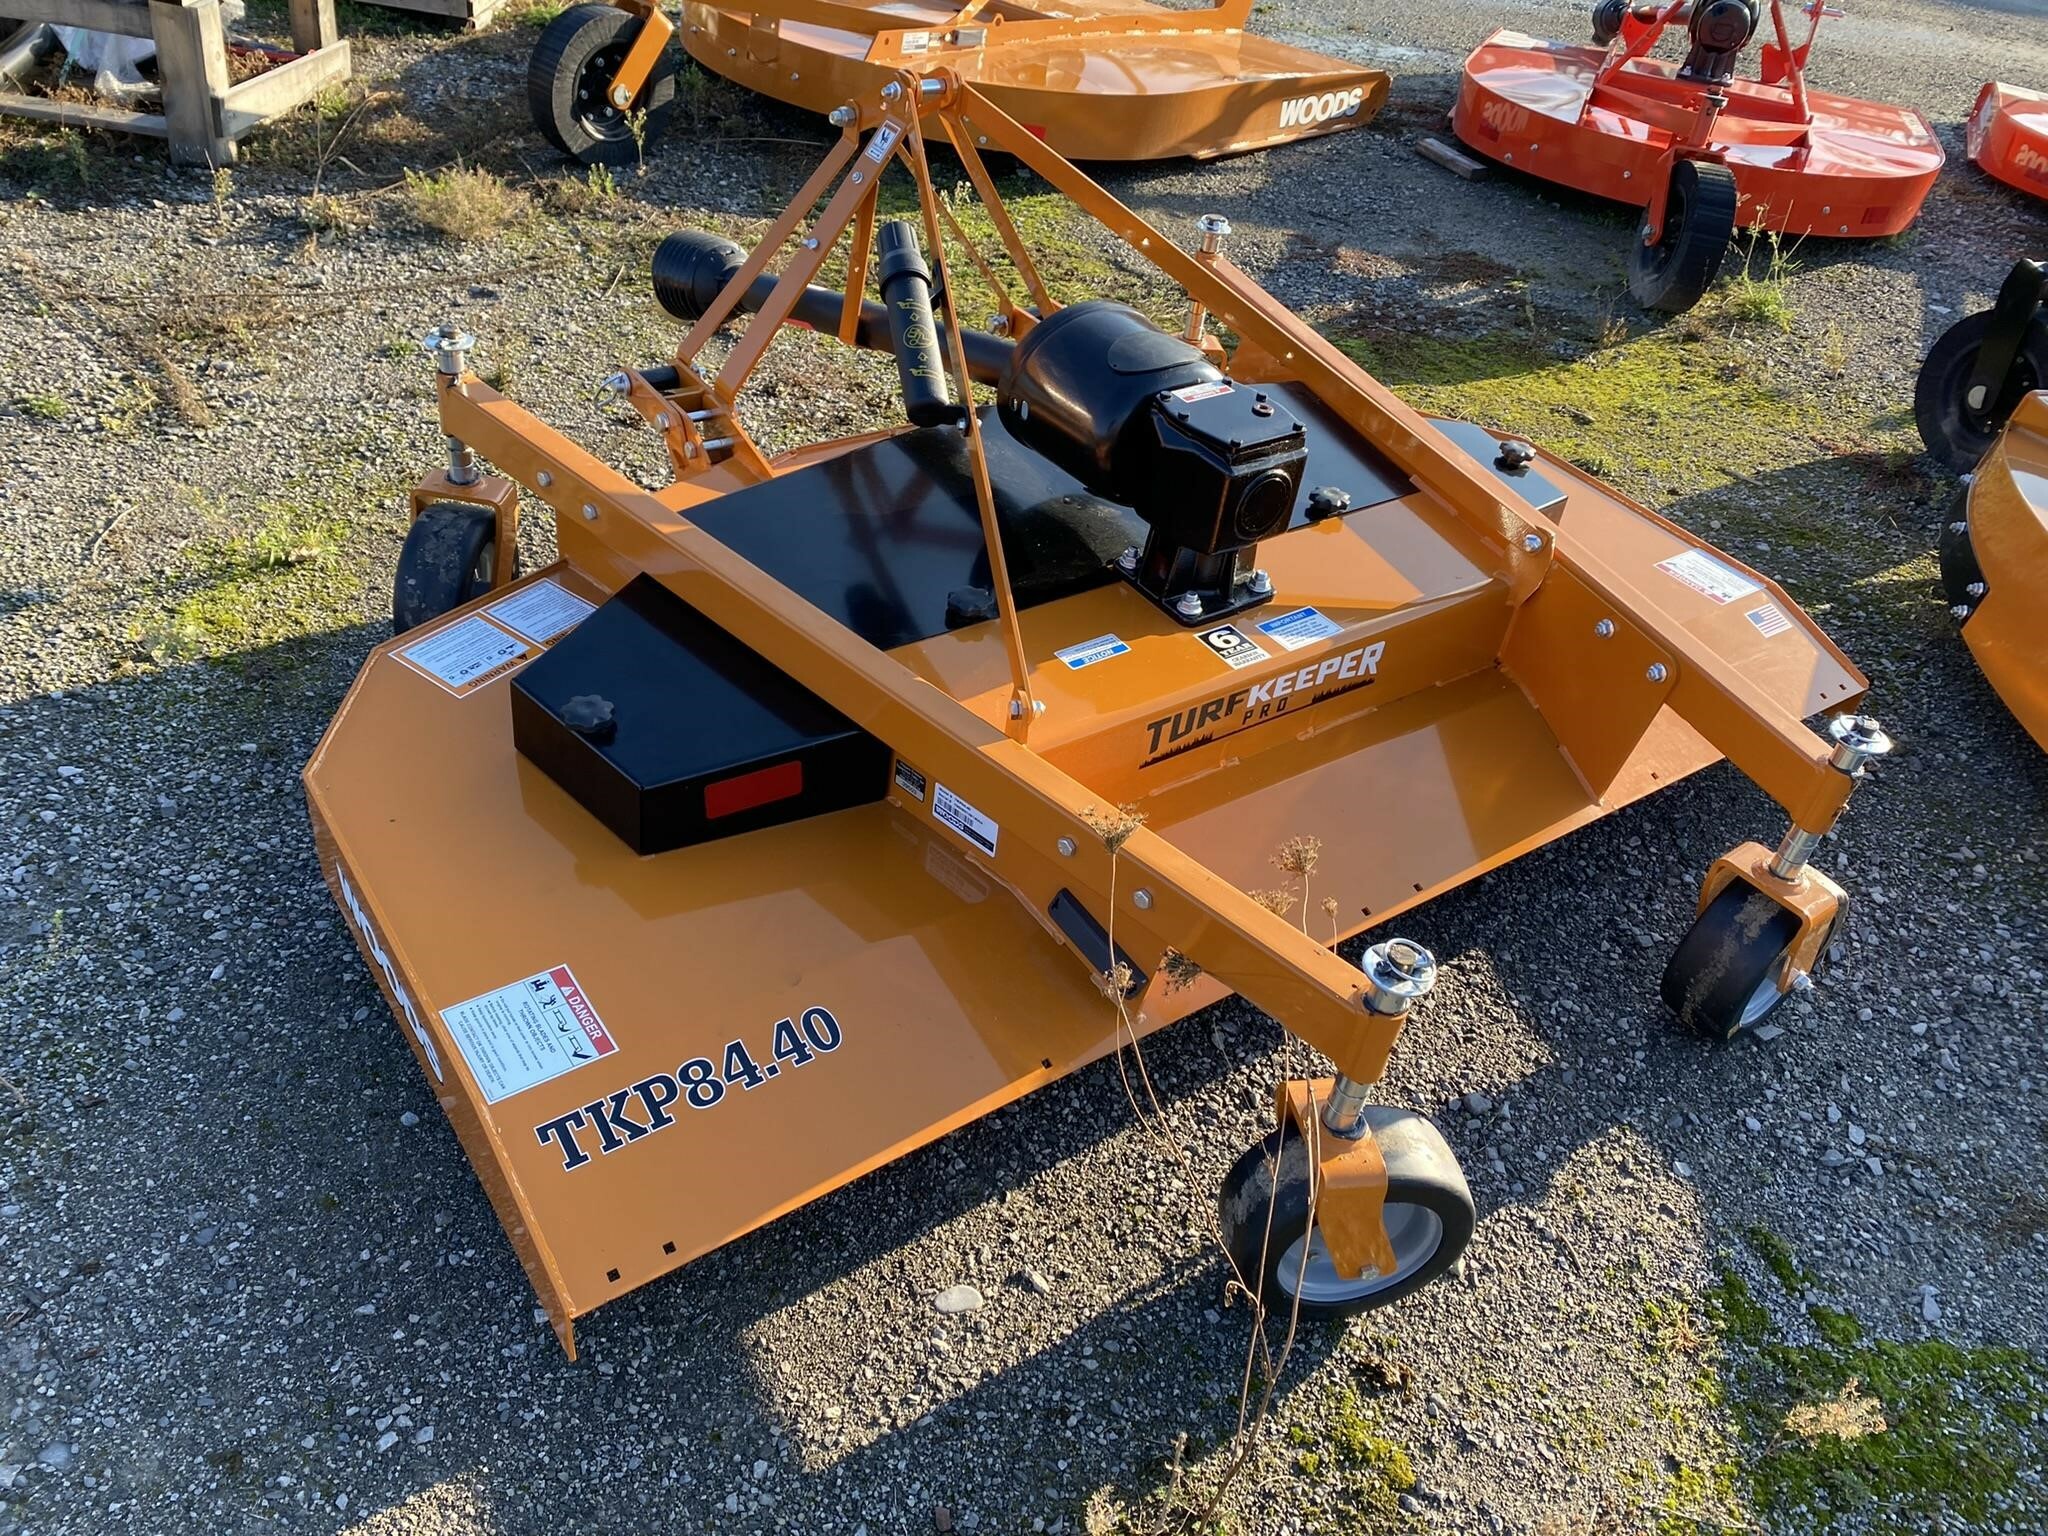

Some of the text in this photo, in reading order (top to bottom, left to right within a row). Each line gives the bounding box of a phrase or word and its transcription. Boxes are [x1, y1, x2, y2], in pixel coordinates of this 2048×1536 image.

[1279, 87, 1363, 129] WOODS
[1208, 629, 1241, 649] 6
[1219, 642, 1253, 656] YEAR
[1082, 647, 1114, 664] NOTICE
[468, 659, 522, 688] WARNING
[1241, 696, 1290, 725] PRO
[567, 995, 603, 1040] DANGER
[533, 1006, 843, 1173] TKP84.40
